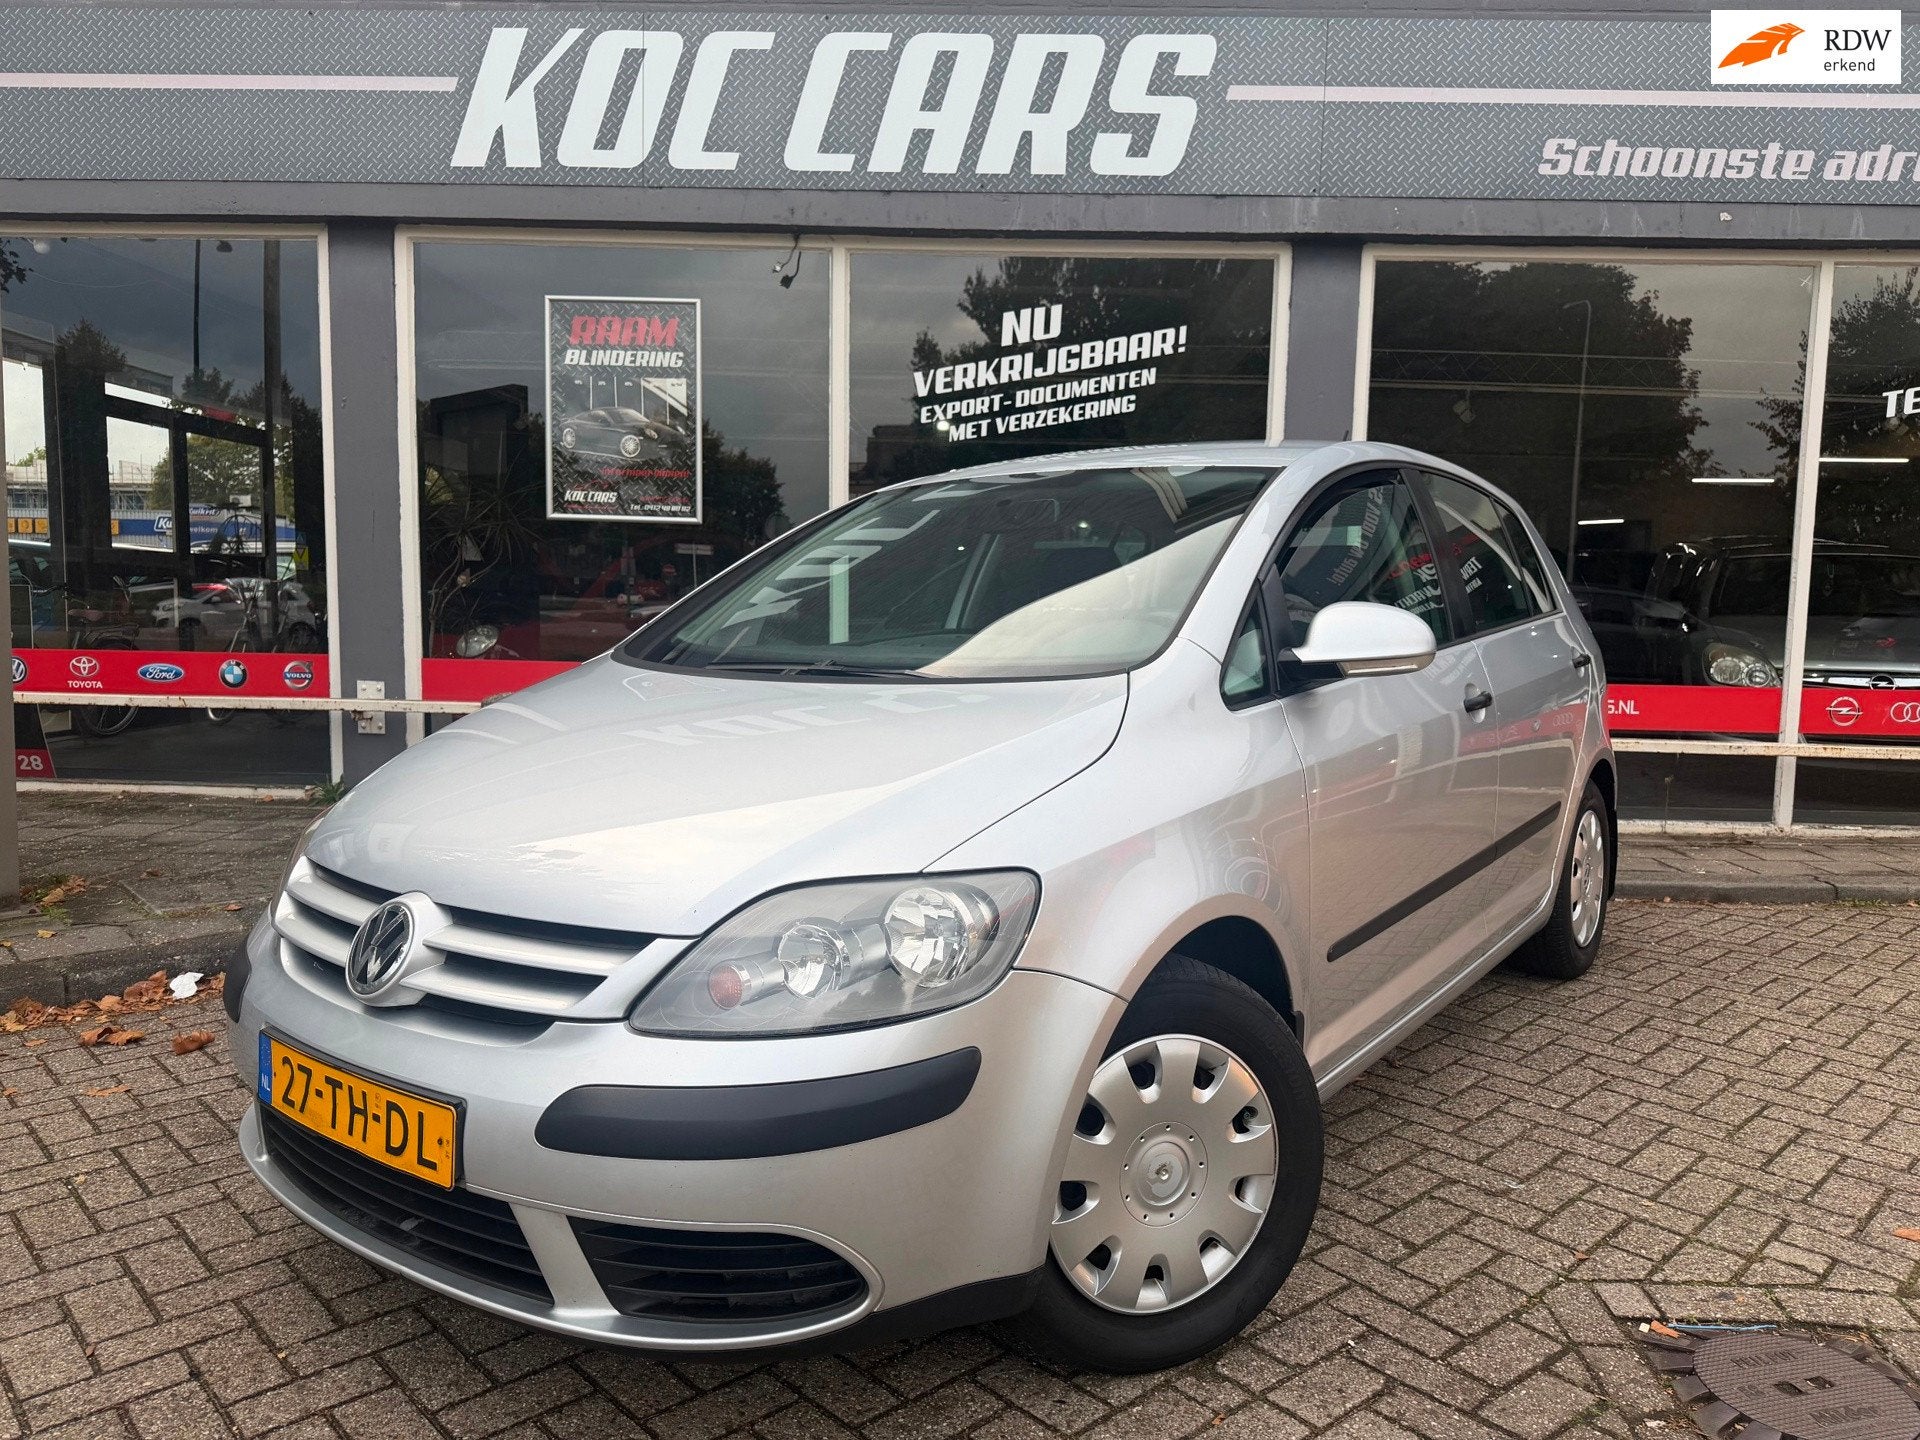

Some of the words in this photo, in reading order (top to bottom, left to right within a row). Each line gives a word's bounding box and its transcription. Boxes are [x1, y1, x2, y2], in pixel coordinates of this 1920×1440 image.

[450, 27, 775, 171] KOC
[784, 32, 1217, 176] CARS
[1538, 138, 1815, 181] Schoonste
[569, 315, 680, 348] RAAM
[1001, 304, 1062, 347] NU
[564, 349, 684, 368] BLINDERING
[913, 325, 1188, 398] VERKRIJGBAAR!
[1015, 367, 1157, 409] DOCUMENTEN
[949, 419, 991, 442] MET
[995, 395, 1136, 434] VERZEKERING
[564, 490, 587, 502] KOC
[587, 491, 618, 503] CARS
[67, 680, 103, 689] TOYOTA
[145, 666, 175, 680] Ford
[17, 755, 43, 770] 28
[261, 1073, 271, 1092] NL
[281, 1056, 438, 1171] 27-TH-DL
